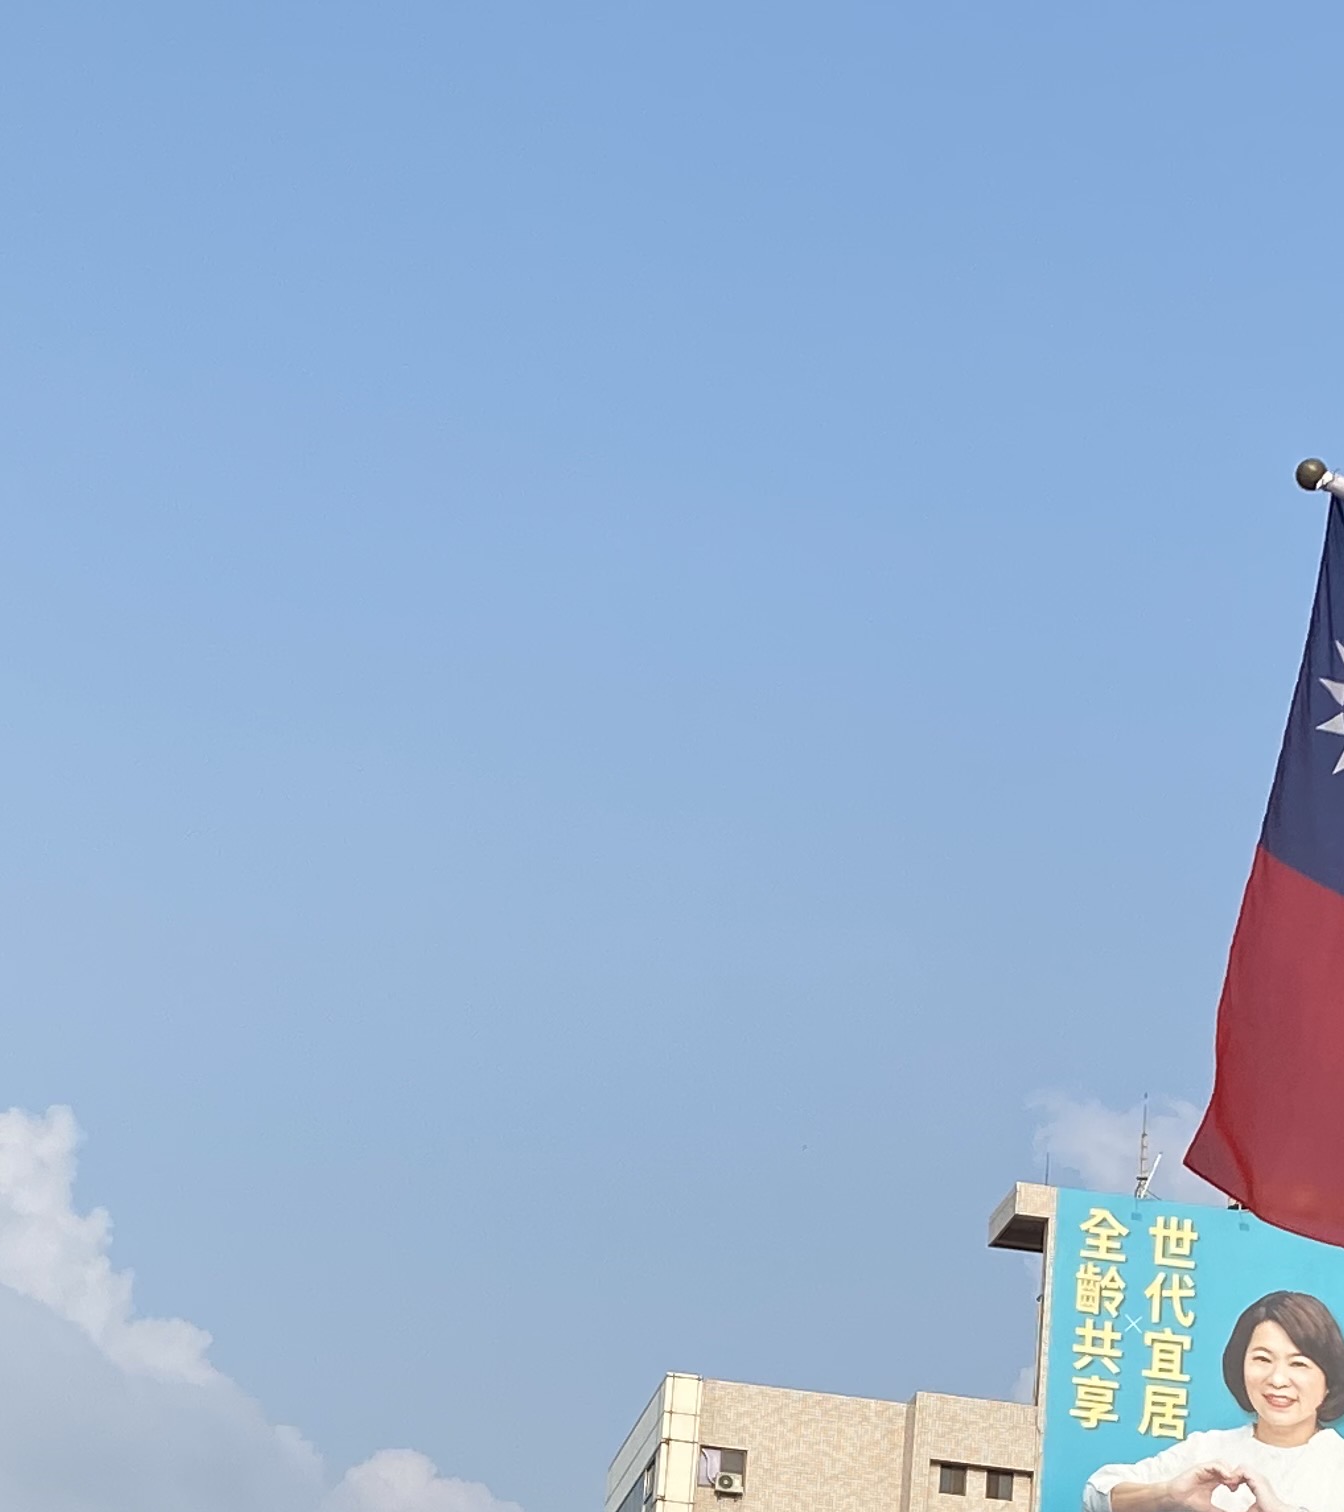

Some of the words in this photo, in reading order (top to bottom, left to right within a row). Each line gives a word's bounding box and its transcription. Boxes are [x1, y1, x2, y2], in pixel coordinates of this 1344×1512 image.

[1069, 1208, 1131, 1430] 全齡共享
[1137, 1215, 1199, 1440] 世代宜居
